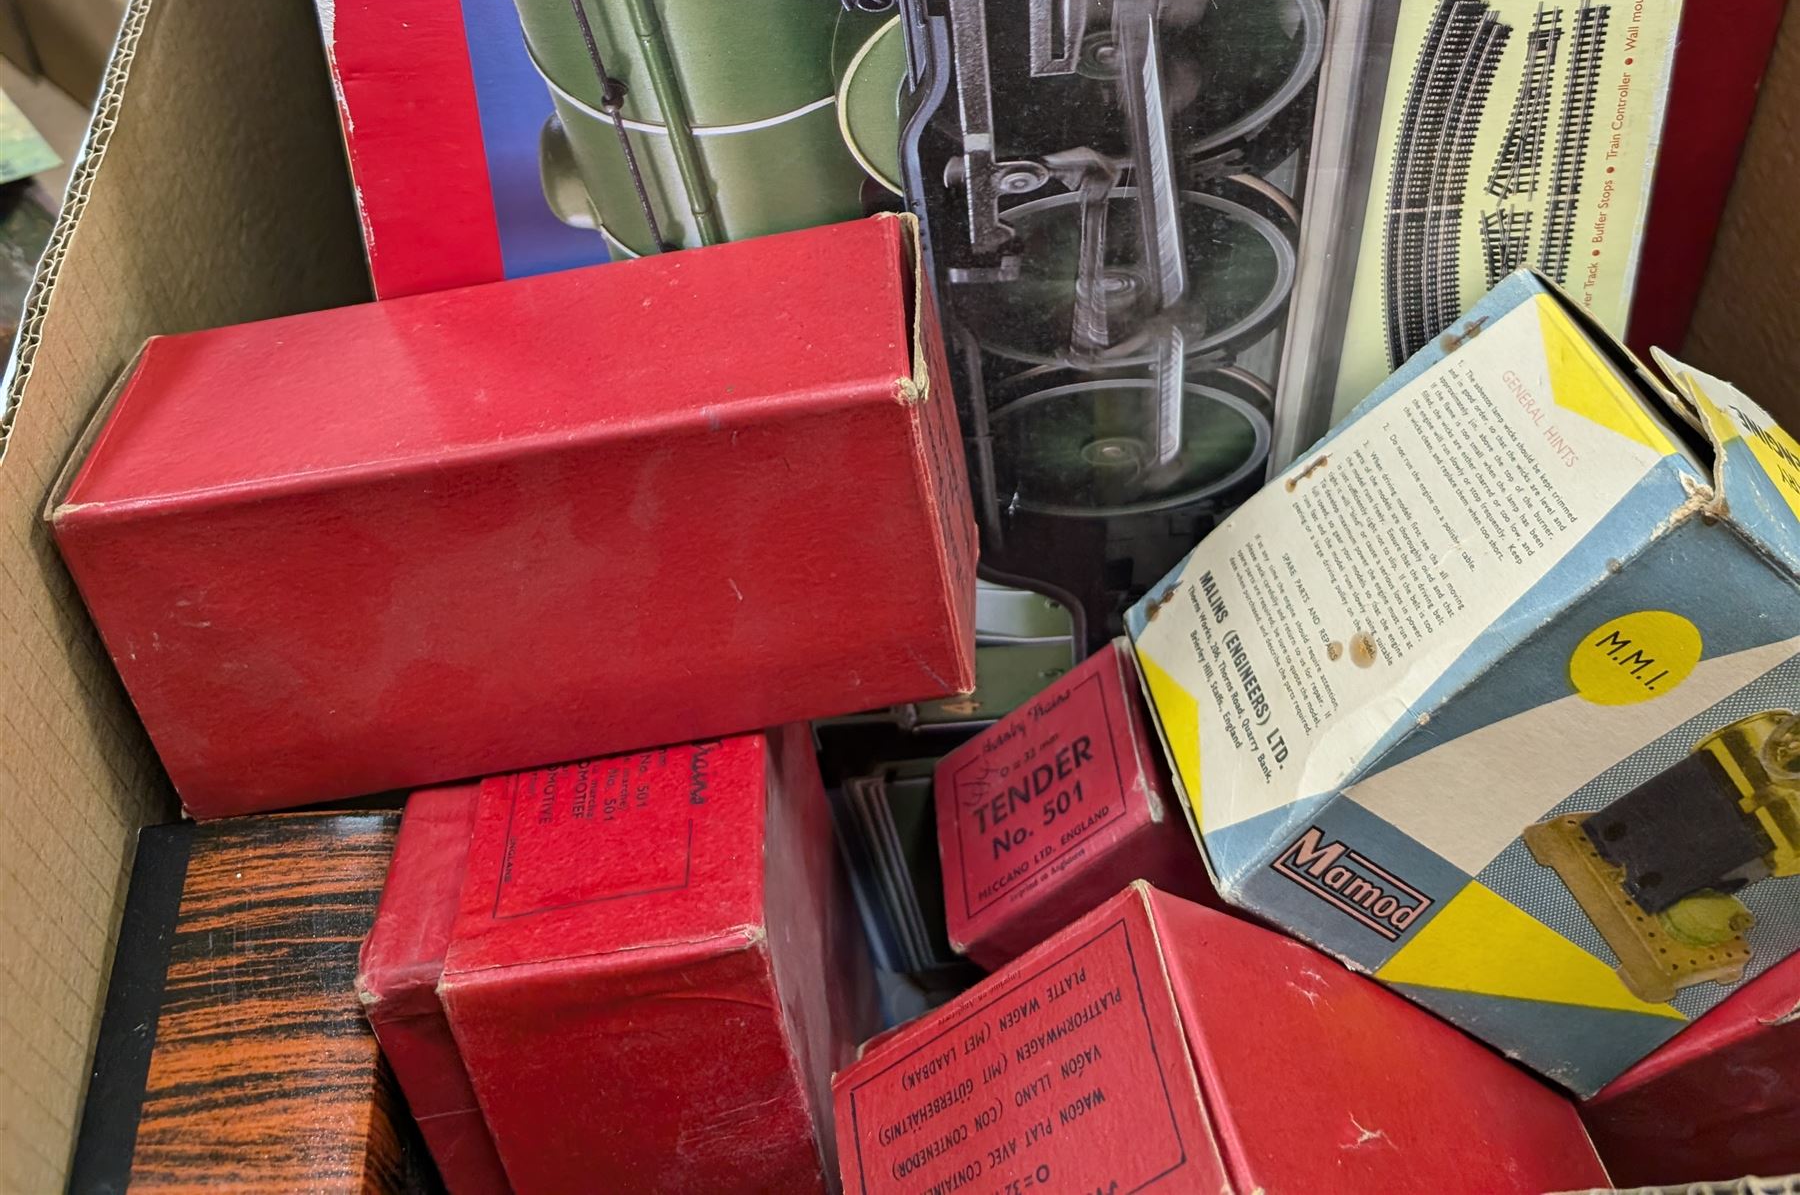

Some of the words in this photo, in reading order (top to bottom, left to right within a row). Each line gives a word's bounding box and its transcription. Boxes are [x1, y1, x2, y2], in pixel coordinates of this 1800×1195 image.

[1624, 25, 1639, 51] Wall
[1611, 72, 1631, 130] Controller
[1605, 133, 1621, 160] Train
[1597, 179, 1614, 209] Stops
[1591, 211, 1607, 243] Buffer
[1583, 262, 1598, 289] Track
[1502, 370, 1545, 427] GENERAL
[1542, 425, 1579, 467] HINTS
[1429, 381, 1437, 389] If
[1434, 389, 1444, 401] the
[1443, 401, 1456, 419] flame
[1460, 427, 1470, 440] too
[1469, 441, 1484, 459] small
[1482, 461, 1496, 479] when
[1495, 480, 1506, 493] the
[1505, 493, 1519, 513] lamp
[1518, 512, 1530, 527] has
[1529, 527, 1544, 548] been
[1439, 375, 1469, 416] approximately
[1478, 433, 1494, 452] above
[1493, 454, 1504, 467] the
[1503, 469, 1514, 482] top
[1514, 484, 1525, 493] of
[1522, 495, 1533, 509] the
[1533, 510, 1554, 540] burner.
[1447, 368, 1459, 380] and
[1456, 378, 1464, 388] in
[1460, 388, 1476, 404] good
[1473, 404, 1488, 425] order,
[1488, 425, 1496, 434] so
[1495, 434, 1507, 449] that
[1505, 449, 1516, 462] the
[1515, 463, 1531, 483] wicks
[1529, 483, 1540, 496] are
[1539, 496, 1556, 515] level
[1552, 516, 1567, 531] and
[1465, 369, 1475, 383] The
[1473, 382, 1493, 408] asbestos
[1491, 405, 1504, 423] lamp
[1503, 423, 1517, 442] wicks
[1515, 441, 1535, 464] should
[1531, 462, 1541, 474] be
[1539, 472, 1553, 491] kept
[1551, 491, 1578, 523] trimmed
[1281, 552, 1297, 576] SPARE
[1294, 578, 1310, 603] PARTS
[1307, 606, 1320, 625] AND
[1319, 628, 1340, 662] REPAIRS
[1187, 584, 1201, 613] Thorns
[1198, 611, 1212, 644] Works,
[1209, 641, 1221, 662] 206,
[1218, 659, 1234, 692] Thorns
[1230, 690, 1245, 719] Road,
[1241, 717, 1259, 752] Quarry
[1257, 752, 1272, 784] Bank,
[1189, 629, 1206, 663] Brierley
[1202, 661, 1214, 683] Hill,
[1209, 680, 1224, 712] Staffs.,
[1222, 711, 1243, 749] England
[1199, 570, 1228, 624] MALINS
[1222, 629, 1271, 726] (ENGINEERS)
[1266, 727, 1288, 770] LTD.
[603, 798, 617, 821] 501
[635, 784, 648, 808] 501
[974, 735, 1093, 834] TENDER
[991, 827, 1033, 860] No.
[1042, 780, 1083, 826] 501
[978, 861, 1029, 900] MECCANO
[1033, 845, 1055, 864] LTD.
[1060, 805, 1109, 846] ENGLAND
[1286, 827, 1432, 934] Mamod
[1046, 967, 1086, 1003] PLATTE
[964, 1022, 991, 1055] (MET
[999, 997, 1040, 1031] WAGEN
[1015, 987, 1121, 1062] PLATTFORMWAGEN
[901, 1046, 956, 1091] LAADBAK)
[982, 1052, 1008, 1084] (MIT
[1014, 1073, 1051, 1107] LLANO
[878, 1078, 973, 1146] GÜTERBEHÄLTNIS)
[973, 1099, 1003, 1132] (CON
[1059, 1087, 1105, 1125] WAGON
[891, 1124, 967, 1180] CONTENEDOR)
[987, 1138, 1017, 1169] AVEC
[1024, 1117, 1052, 1147] PLAT
